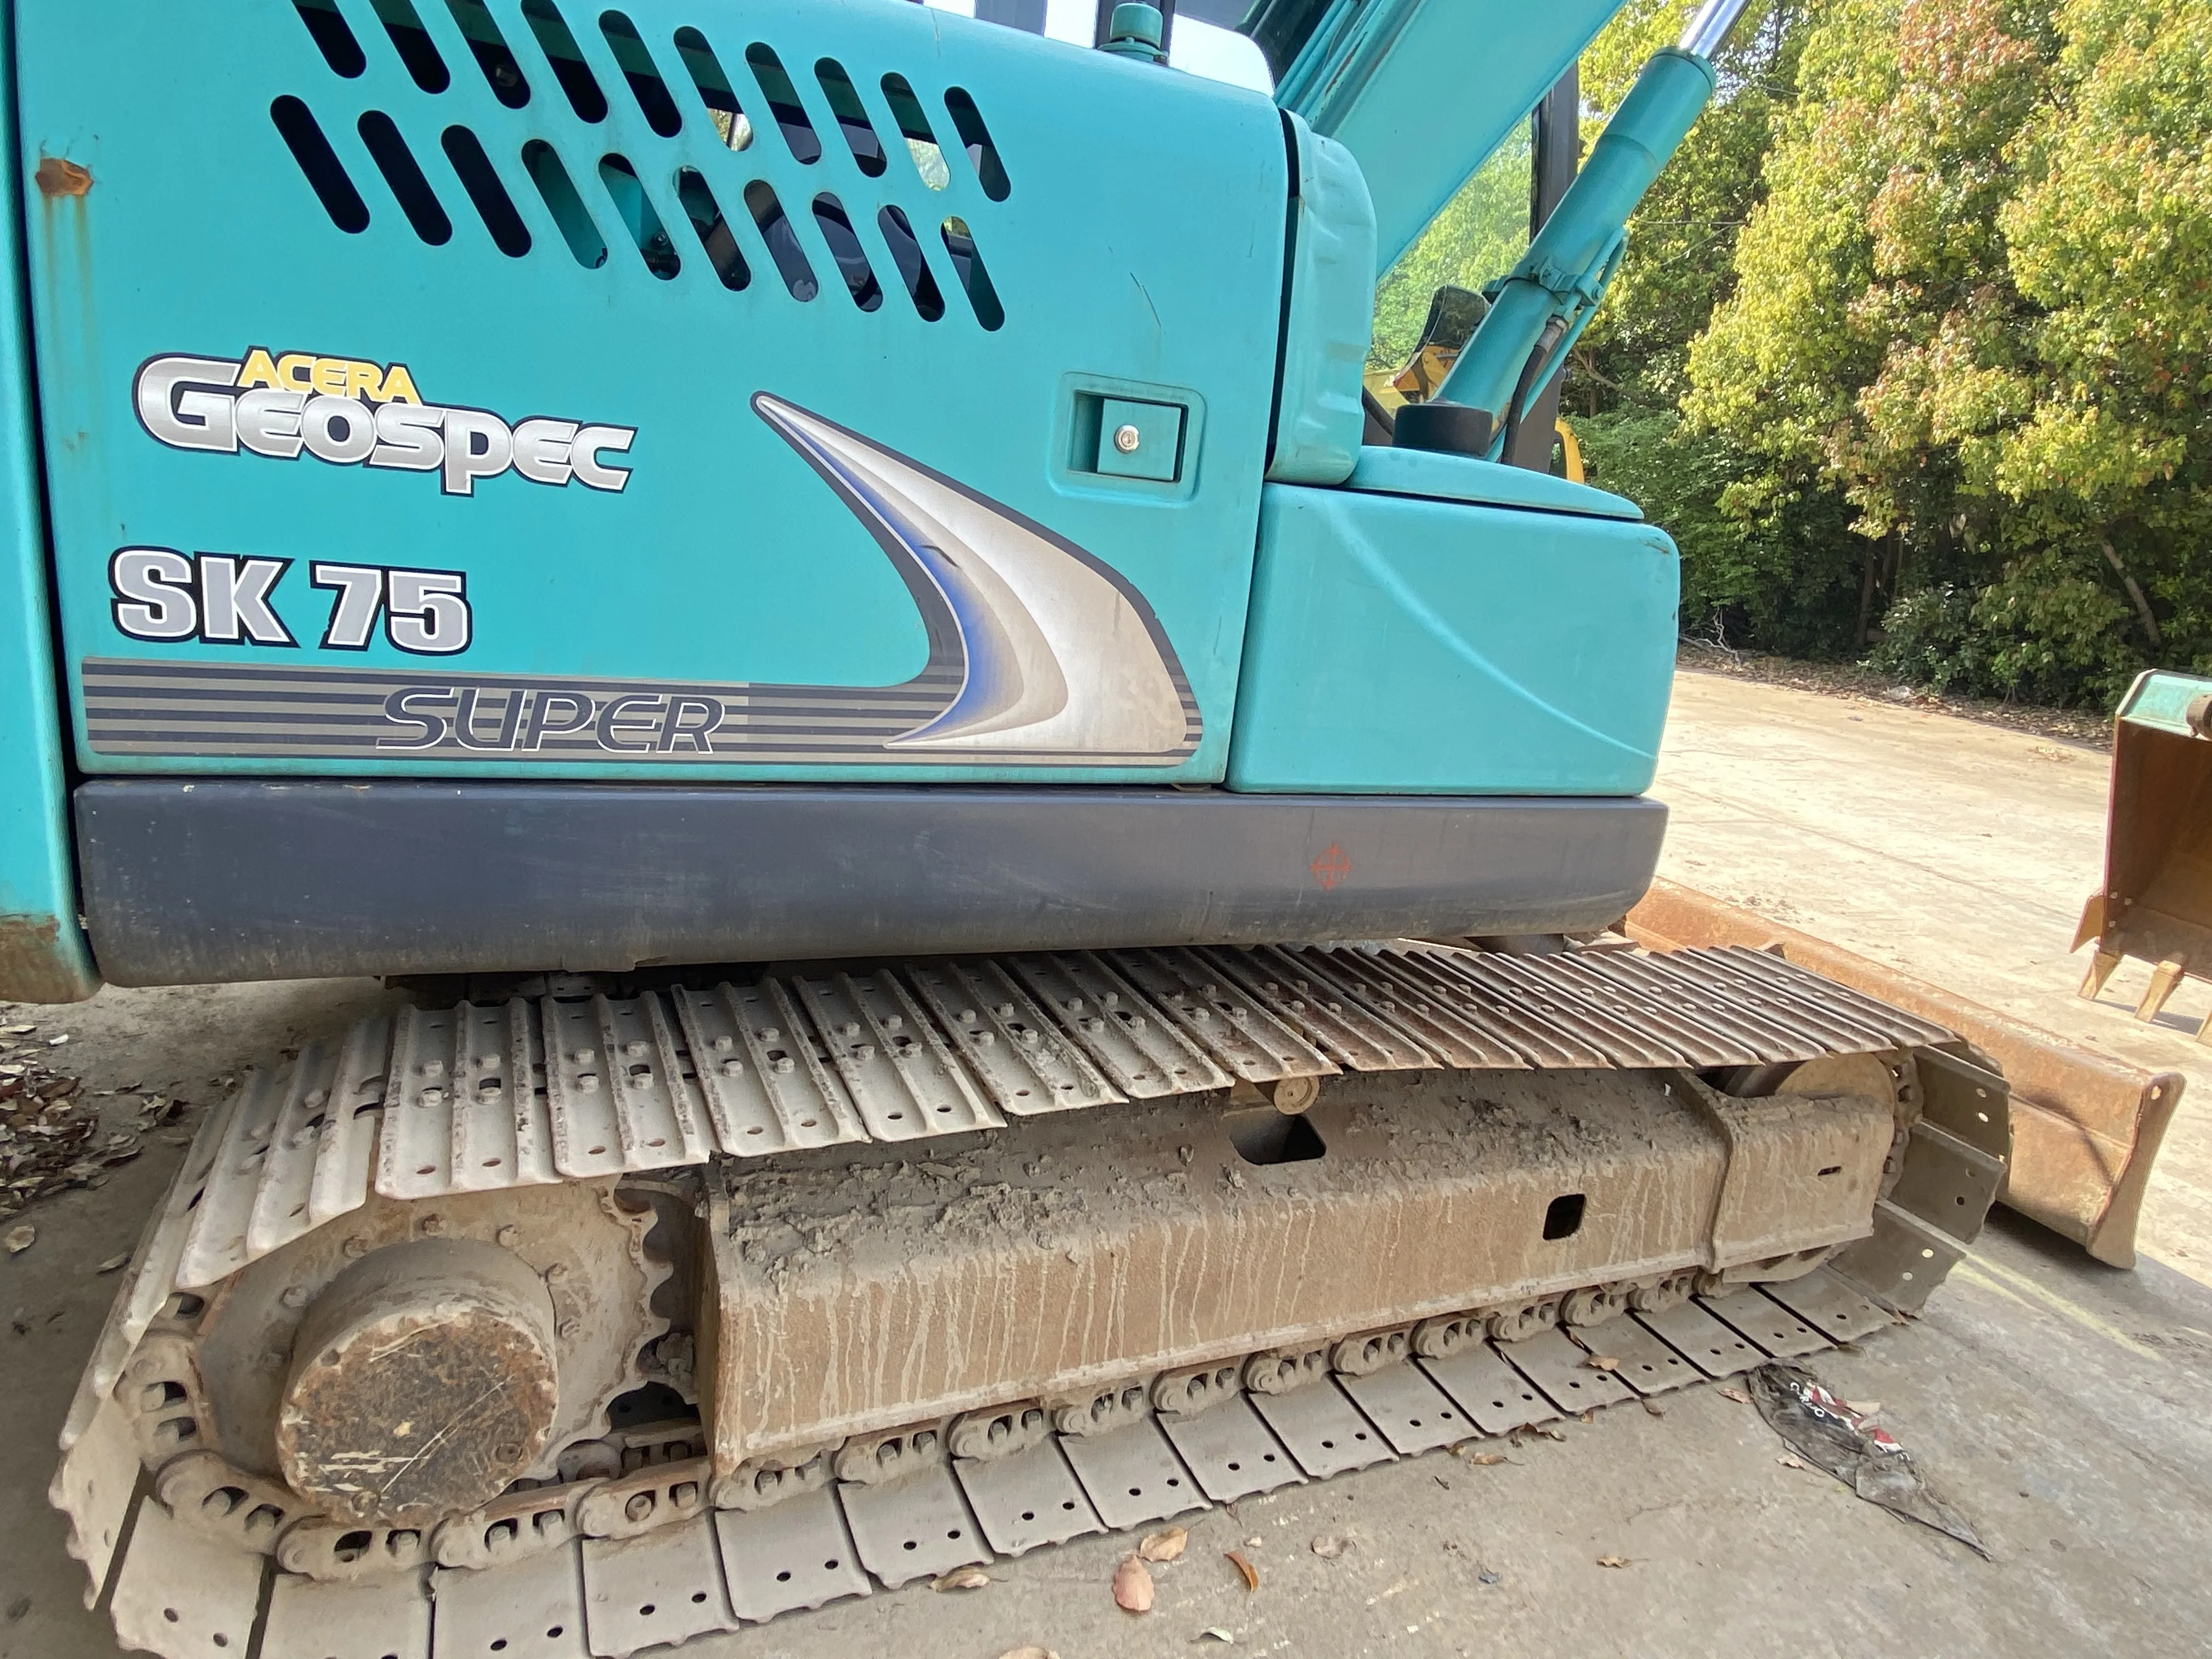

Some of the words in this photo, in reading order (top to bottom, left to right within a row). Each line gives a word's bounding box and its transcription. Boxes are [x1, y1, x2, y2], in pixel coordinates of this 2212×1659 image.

[237, 347, 424, 405] ACERA
[109, 547, 300, 648] SK
[310, 561, 472, 654] 75
[376, 687, 725, 754] SUPER
